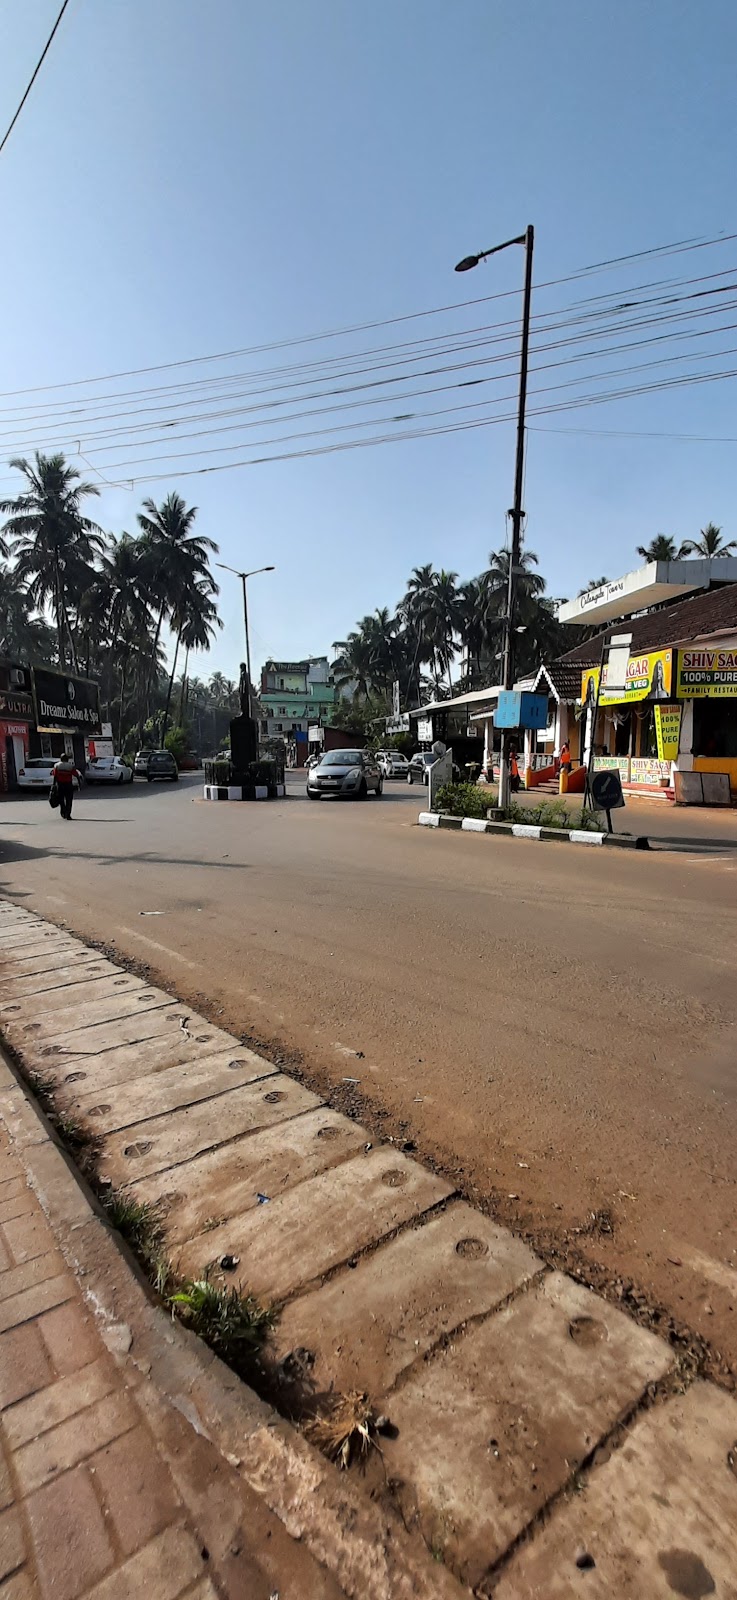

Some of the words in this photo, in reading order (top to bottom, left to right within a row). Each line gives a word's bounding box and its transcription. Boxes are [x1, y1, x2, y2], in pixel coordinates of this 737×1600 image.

[683, 653, 715, 667] SHIV
[626, 658, 649, 678] GAR
[683, 672, 711, 682] 100%
[632, 680, 648, 689] VEG
[8, 701, 32, 714] ULTRA
[40, 700, 67, 718] Dreamz
[67, 705, 84, 721] Salon
[84, 708, 89, 721] &
[89, 709, 99, 725] Spa
[661, 715, 680, 723] 100%
[663, 735, 678, 743] VEG
[631, 760, 648, 769] SHIV
